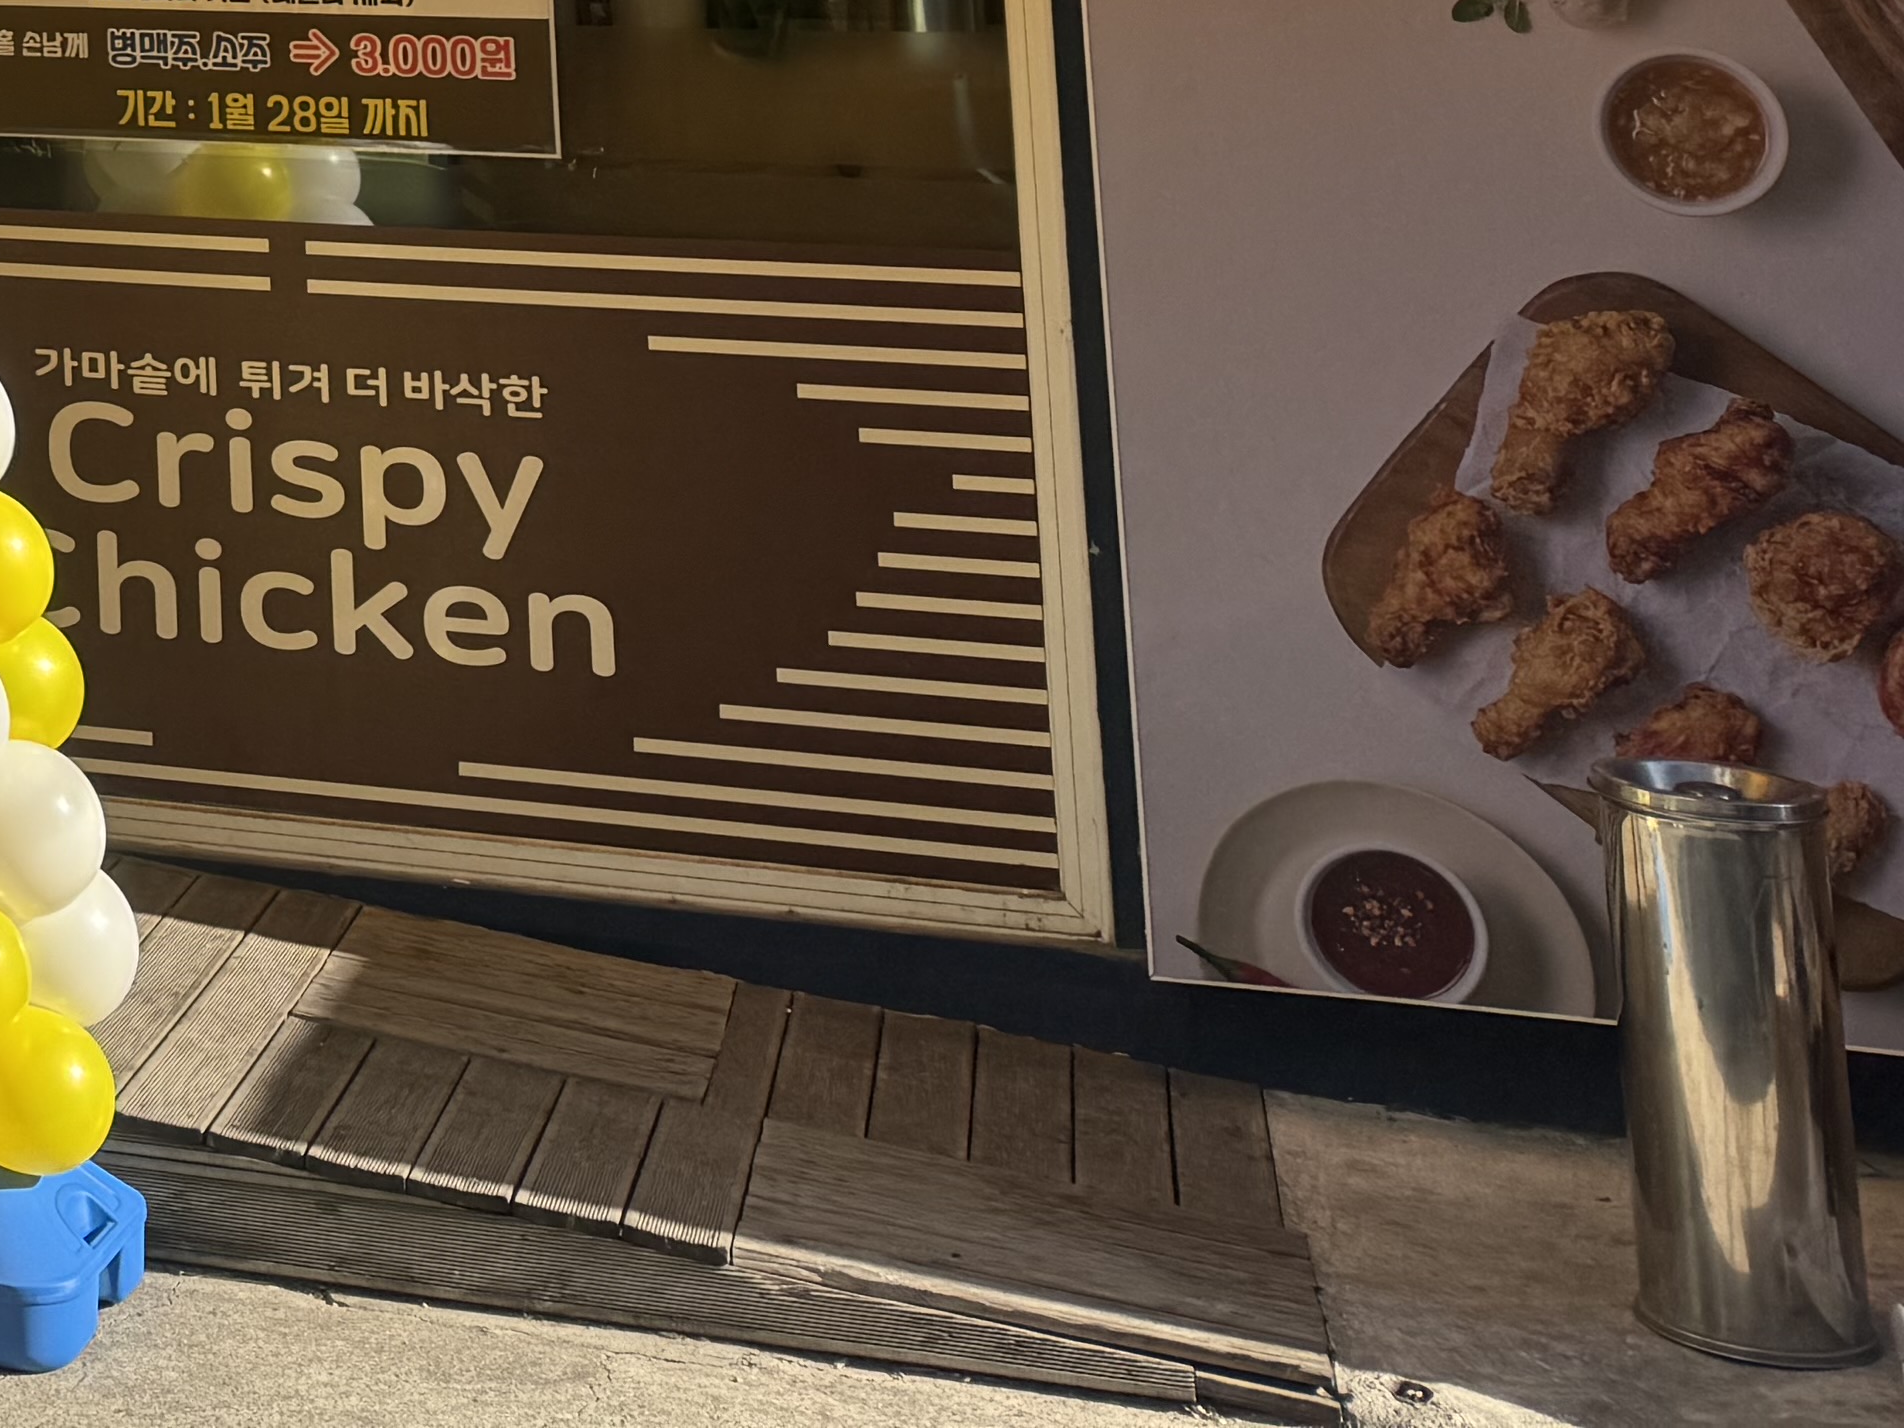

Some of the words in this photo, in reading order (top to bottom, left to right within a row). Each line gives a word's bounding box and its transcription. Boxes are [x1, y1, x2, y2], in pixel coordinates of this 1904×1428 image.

[349, 32, 517, 81] 3.000원
[116, 89, 177, 128] 기간
[207, 92, 255, 130] 1월
[267, 94, 350, 135] 28일
[361, 97, 429, 137] 까지
[34, 346, 218, 398] 가마솥에
[238, 359, 332, 404] 튀겨
[345, 366, 390, 410] 더
[402, 371, 549, 419] 바삭한
[47, 399, 545, 561] Crispy
[48, 527, 617, 678] hicken
